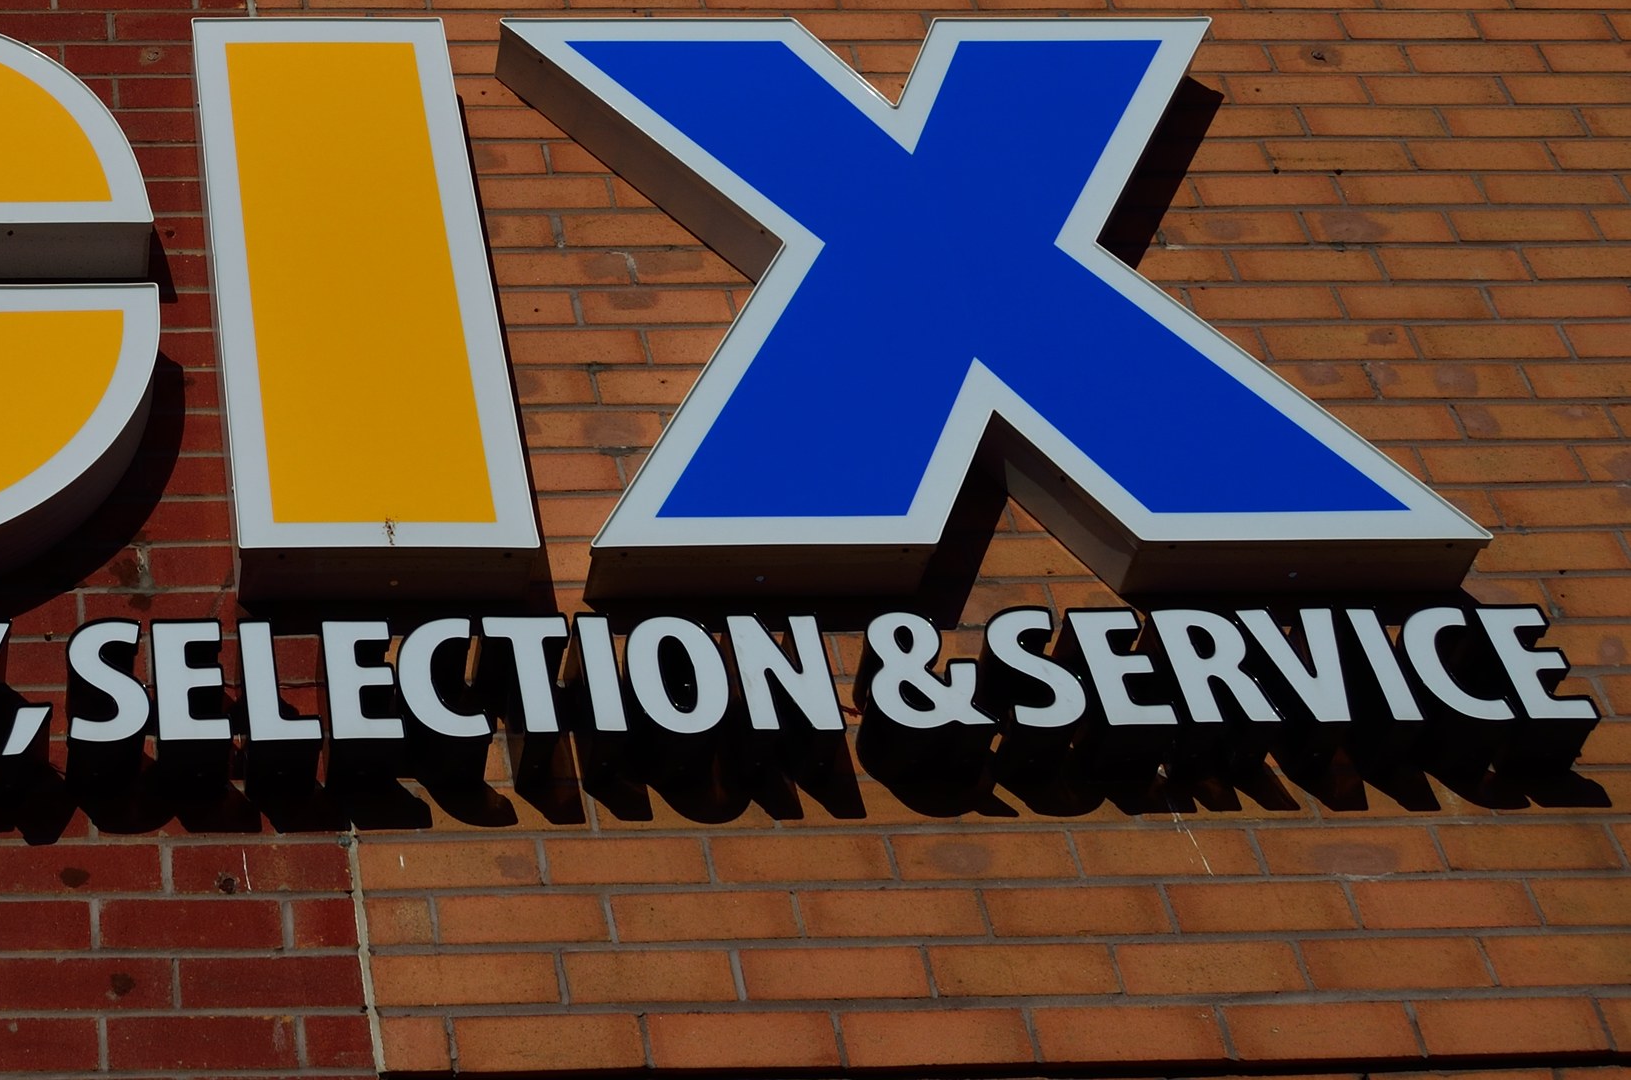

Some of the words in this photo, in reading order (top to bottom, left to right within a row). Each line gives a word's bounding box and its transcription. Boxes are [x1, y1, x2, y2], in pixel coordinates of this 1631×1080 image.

[68, 615, 844, 742] SELECTION
[867, 612, 996, 729] &
[987, 607, 1598, 728] SERVICE
